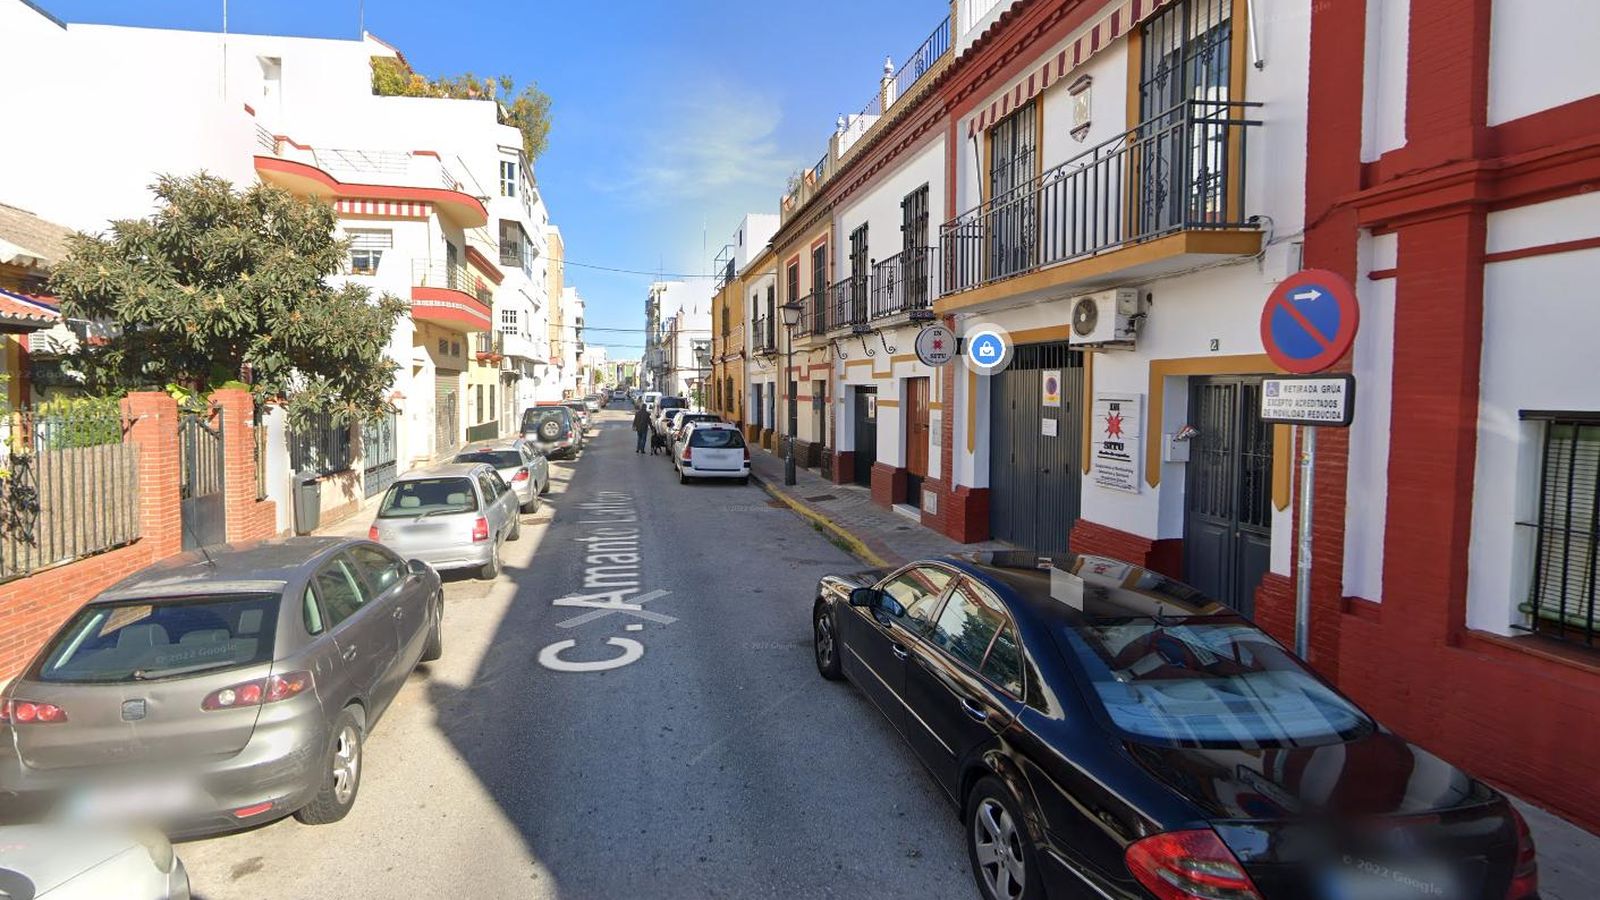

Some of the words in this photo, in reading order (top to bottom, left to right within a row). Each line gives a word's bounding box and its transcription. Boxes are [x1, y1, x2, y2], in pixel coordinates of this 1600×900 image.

[1283, 384, 1318, 394] RETIRADA
[1321, 383, 1341, 394] GRÚA
[1109, 402, 1120, 411] IN
[1267, 398, 1293, 407] EXCEPTO
[1295, 399, 1338, 408] ACREDITADOS
[1263, 408, 1271, 417] DE
[1272, 408, 1305, 418] MOVILIDAD
[1307, 409, 1341, 419] REDUCIDA
[1103, 441, 1124, 451] SITU
